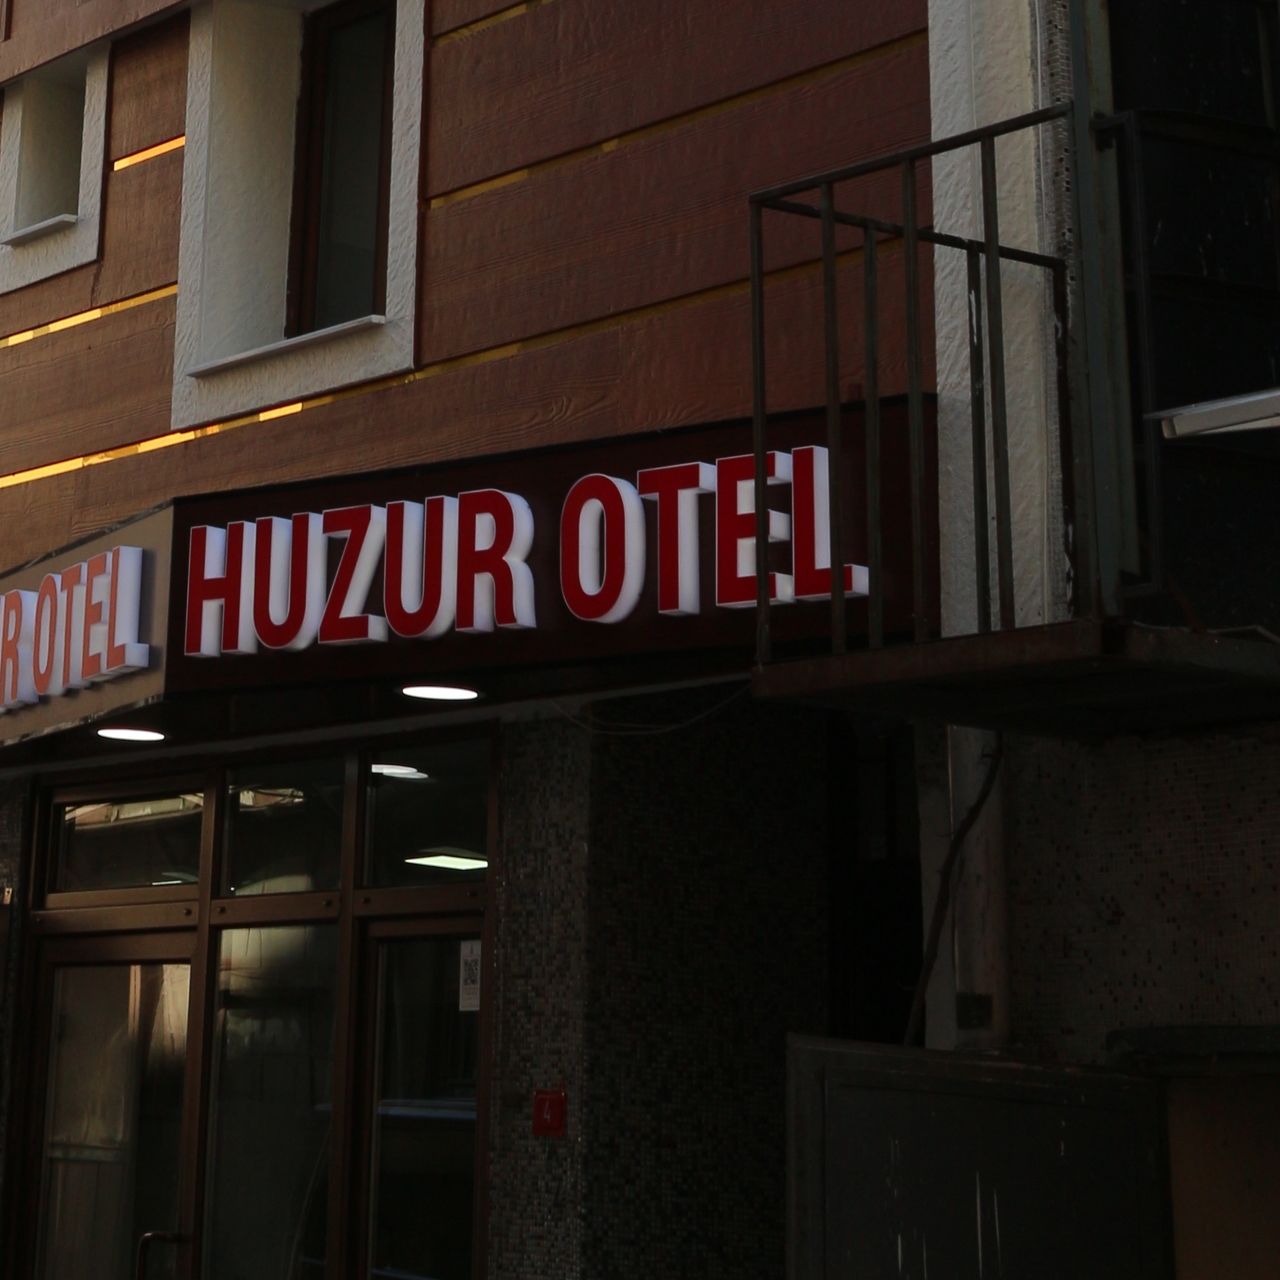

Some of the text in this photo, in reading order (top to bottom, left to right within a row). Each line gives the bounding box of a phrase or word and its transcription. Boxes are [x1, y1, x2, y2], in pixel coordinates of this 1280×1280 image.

[32, 545, 150, 696] OTEL
[186, 444, 869, 658] HUZUR OTEL
[543, 1100, 552, 1124] 4
